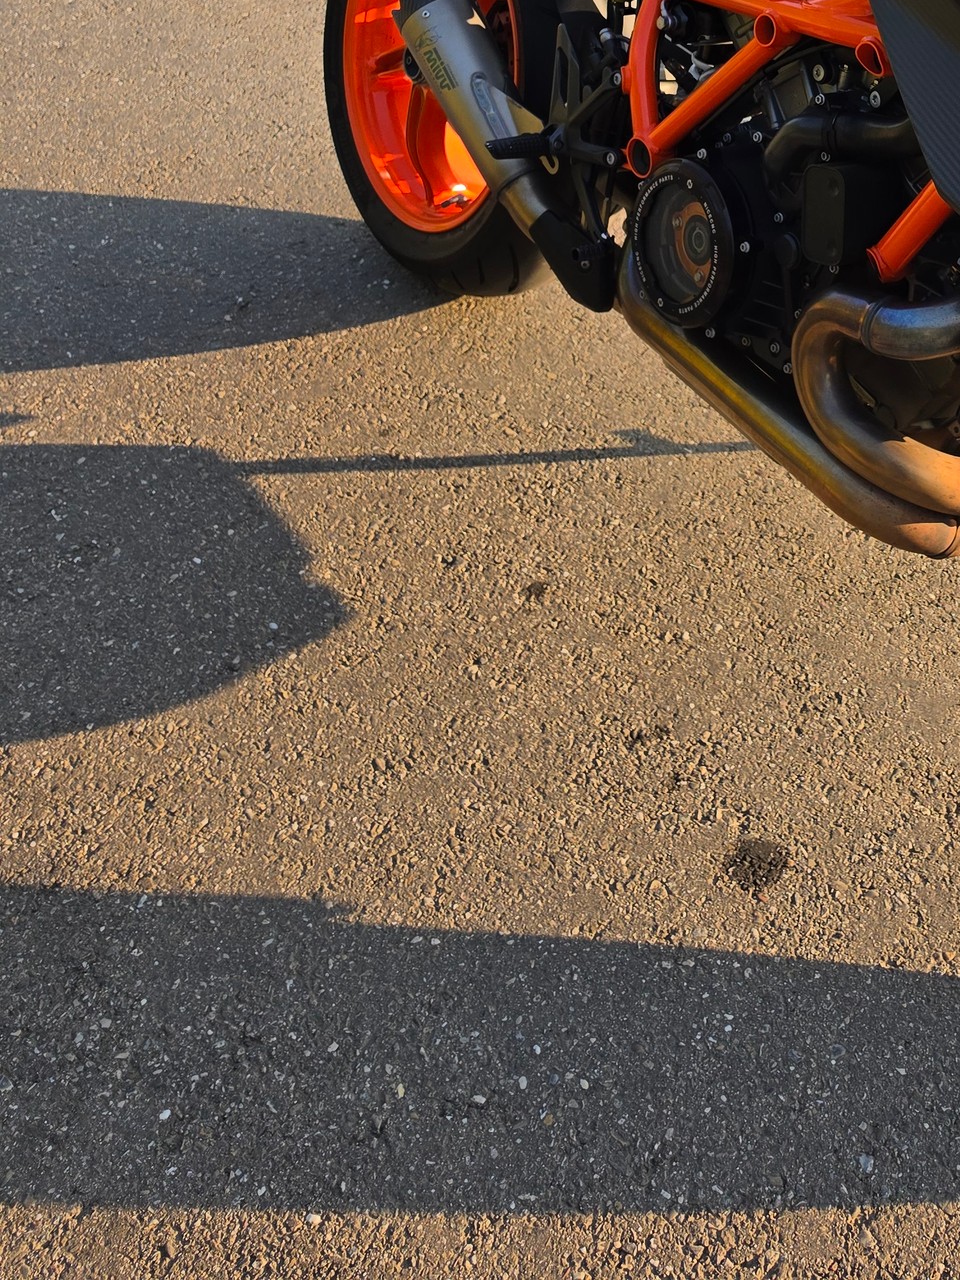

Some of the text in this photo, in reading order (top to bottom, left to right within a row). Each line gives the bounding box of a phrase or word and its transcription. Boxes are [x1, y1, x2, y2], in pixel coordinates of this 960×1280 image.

[635, 181, 659, 221] PERFORMANCE
[658, 174, 674, 184] PARTS
[693, 265, 717, 309] PERFORMANCE
